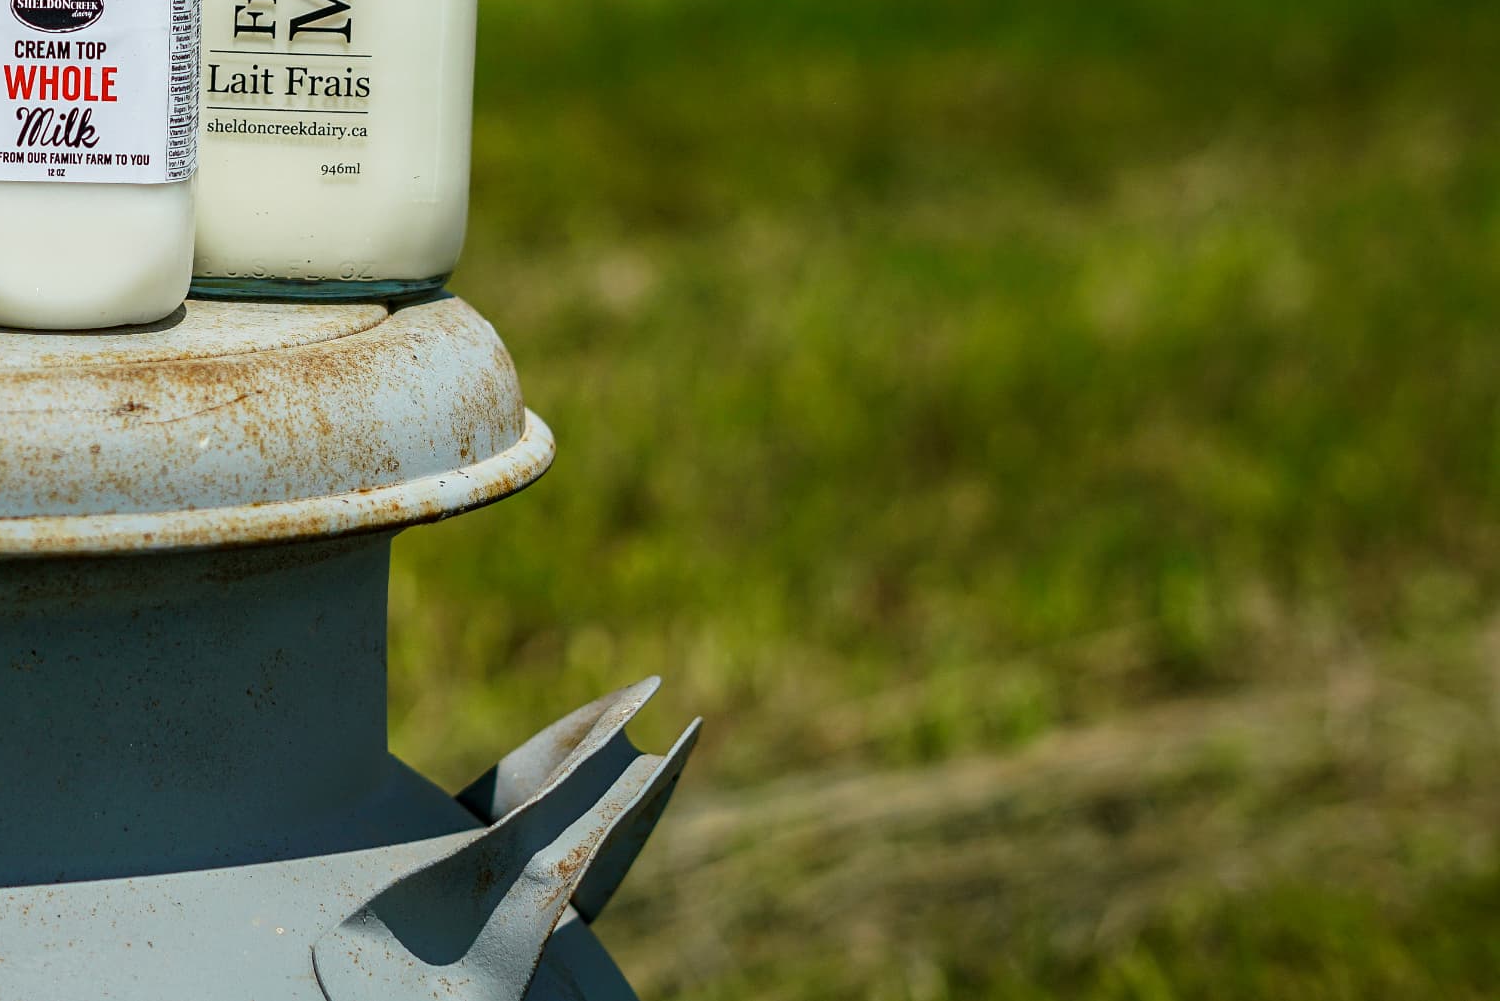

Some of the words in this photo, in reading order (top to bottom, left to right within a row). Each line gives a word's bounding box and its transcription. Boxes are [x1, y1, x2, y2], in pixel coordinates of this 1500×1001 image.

[14, 40, 71, 60] CREAM
[75, 41, 107, 61] TOP
[3, 64, 118, 102] WHOLE
[207, 64, 275, 97] Lait
[284, 66, 371, 98] Frais
[15, 106, 101, 149] Milk
[206, 119, 368, 139] sheldoncreekdairy.ca
[27, 152, 48, 165] OUR
[49, 152, 84, 166] FAMILY
[85, 153, 113, 166] FARM
[115, 153, 128, 166] TO
[130, 154, 150, 166] YOU
[320, 161, 361, 175] 946ml
[47, 168, 56, 177] 12
[56, 168, 66, 177] OZ
